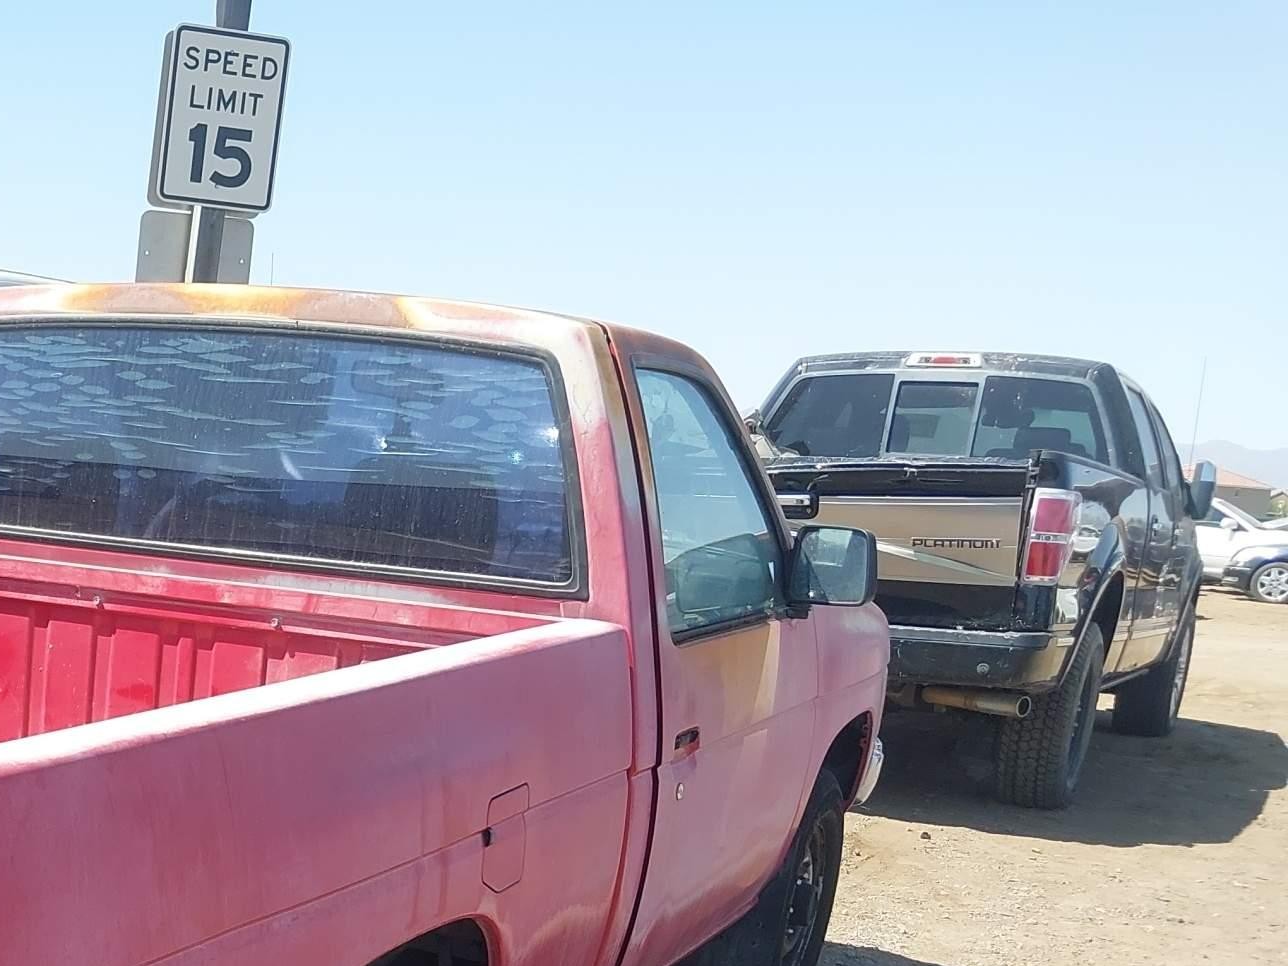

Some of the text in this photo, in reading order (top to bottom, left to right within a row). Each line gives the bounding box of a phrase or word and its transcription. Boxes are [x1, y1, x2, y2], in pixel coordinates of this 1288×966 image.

[183, 46, 278, 80] SPEED
[189, 84, 264, 116] LIMIT
[188, 122, 253, 188] 15
[911, 538, 1001, 549] PLATINUM
